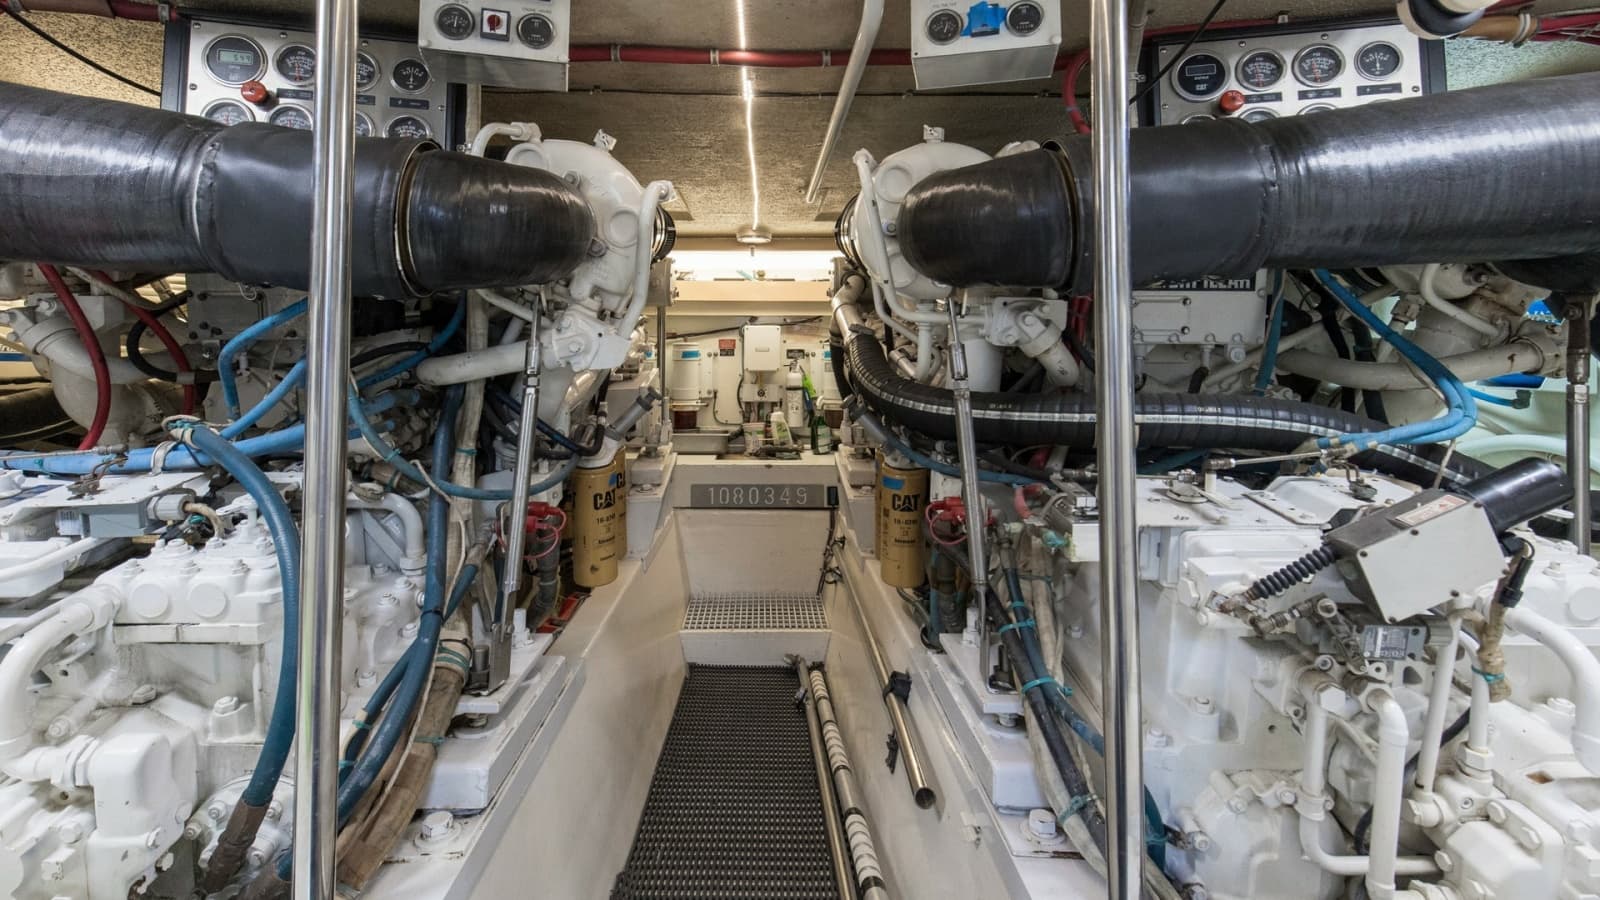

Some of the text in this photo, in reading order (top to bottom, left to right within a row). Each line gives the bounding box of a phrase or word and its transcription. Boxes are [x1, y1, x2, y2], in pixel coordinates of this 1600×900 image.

[593, 489, 616, 510] CAT
[707, 487, 808, 505] 1080349
[892, 493, 921, 512] CAT
